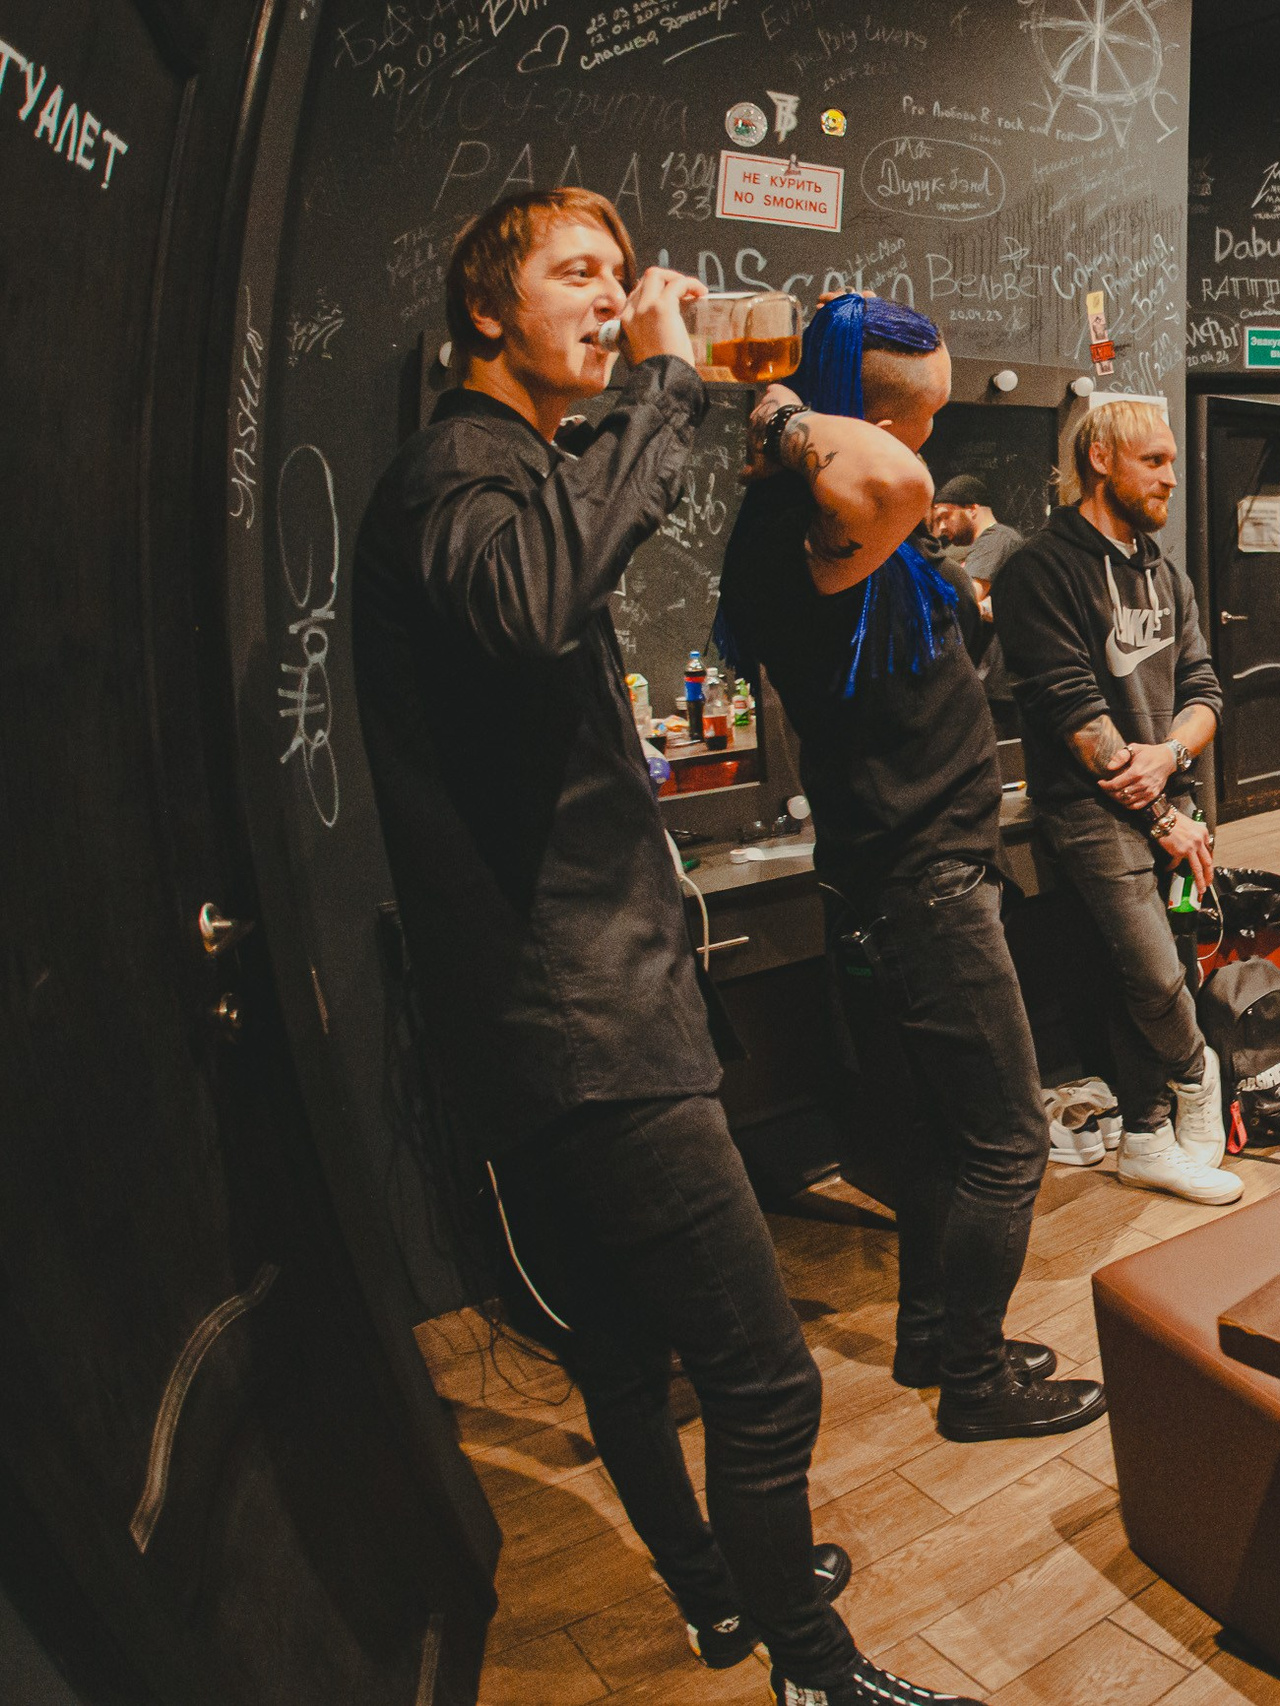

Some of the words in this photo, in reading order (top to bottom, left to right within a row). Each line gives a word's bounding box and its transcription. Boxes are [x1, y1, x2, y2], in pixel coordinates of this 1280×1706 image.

[742, 171, 761, 185] НЕ
[770, 174, 823, 193] КУРИТЬ
[733, 190, 754, 204] NO
[763, 194, 828, 214] SMOKING
